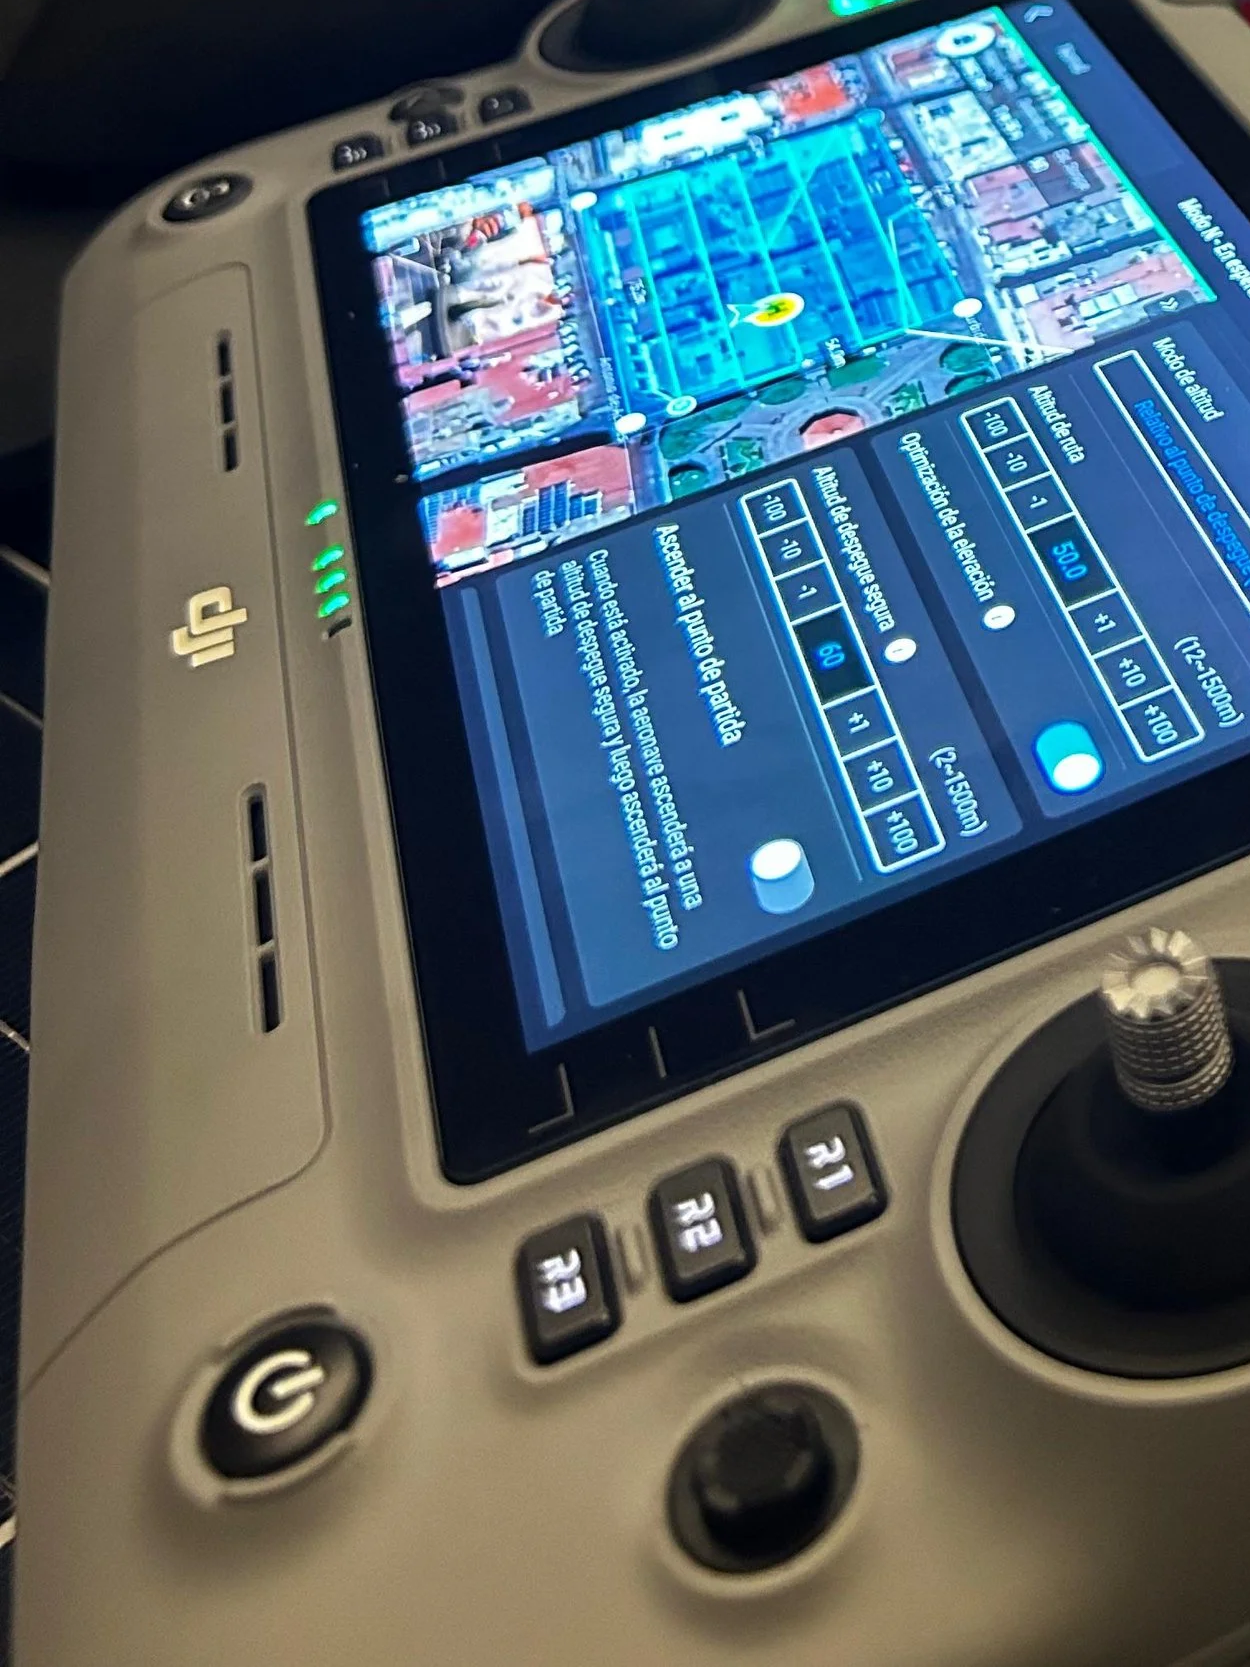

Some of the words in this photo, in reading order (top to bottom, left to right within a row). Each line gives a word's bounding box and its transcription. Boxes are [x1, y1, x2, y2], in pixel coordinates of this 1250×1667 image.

[1152, 337, 1184, 370] Modo
[1175, 369, 1195, 385] de
[1185, 384, 1223, 421] altitud
[979, 408, 1009, 438] -100
[1027, 385, 1065, 423] Altitud
[1134, 400, 1172, 445] Relativo
[1050, 422, 1071, 438] de
[1001, 450, 1028, 473] -10
[1059, 436, 1084, 463] ruta
[1164, 446, 1185, 458] al
[811, 467, 846, 507] Altitud
[899, 432, 949, 509] Optimización
[1168, 458, 1203, 494] punto
[758, 491, 788, 523] -100
[828, 506, 850, 524] de
[937, 508, 958, 526] de
[1025, 493, 1048, 510] -1
[1195, 494, 1215, 511] de
[776, 535, 802, 561] -10
[945, 523, 965, 540] la
[652, 525, 694, 594] Ascender
[835, 522, 874, 585] despegue
[952, 539, 994, 602] elevación
[1048, 540, 1090, 582] 50.0
[531, 570, 554, 589] de
[559, 560, 590, 602] altitud
[585, 549, 617, 599] Cuando
[794, 582, 817, 600] -1
[534, 587, 566, 636] partida
[570, 601, 592, 619] de
[599, 600, 628, 631] está
[675, 593, 704, 613] al
[862, 584, 894, 632] segura
[1088, 610, 1117, 634] +1
[575, 620, 606, 686] despegue
[675, 610, 713, 659] punto
[608, 630, 642, 694] activado,
[696, 657, 724, 682] de
[815, 639, 847, 670] 60
[1113, 655, 1147, 689] +10
[625, 689, 647, 708] la
[1174, 636, 1243, 727] (12~1500m)
[592, 686, 619, 737] segura
[698, 680, 745, 747] partida
[843, 709, 870, 735] +1
[1137, 701, 1180, 747] +100
[600, 734, 623, 747] y
[629, 707, 663, 775] aeronave
[608, 744, 634, 791] luego
[862, 757, 894, 794] +10
[928, 747, 986, 836] (2~1500m)
[620, 791, 663, 877] ascenderá
[649, 776, 693, 860] ascenderá
[881, 807, 919, 855] +100
[672, 859, 691, 874] a
[642, 877, 668, 895] al
[675, 872, 701, 909] una
[642, 894, 677, 949] punto
[804, 1136, 854, 1190] R1
[674, 1191, 723, 1253] R2
[537, 1247, 587, 1313] R3
